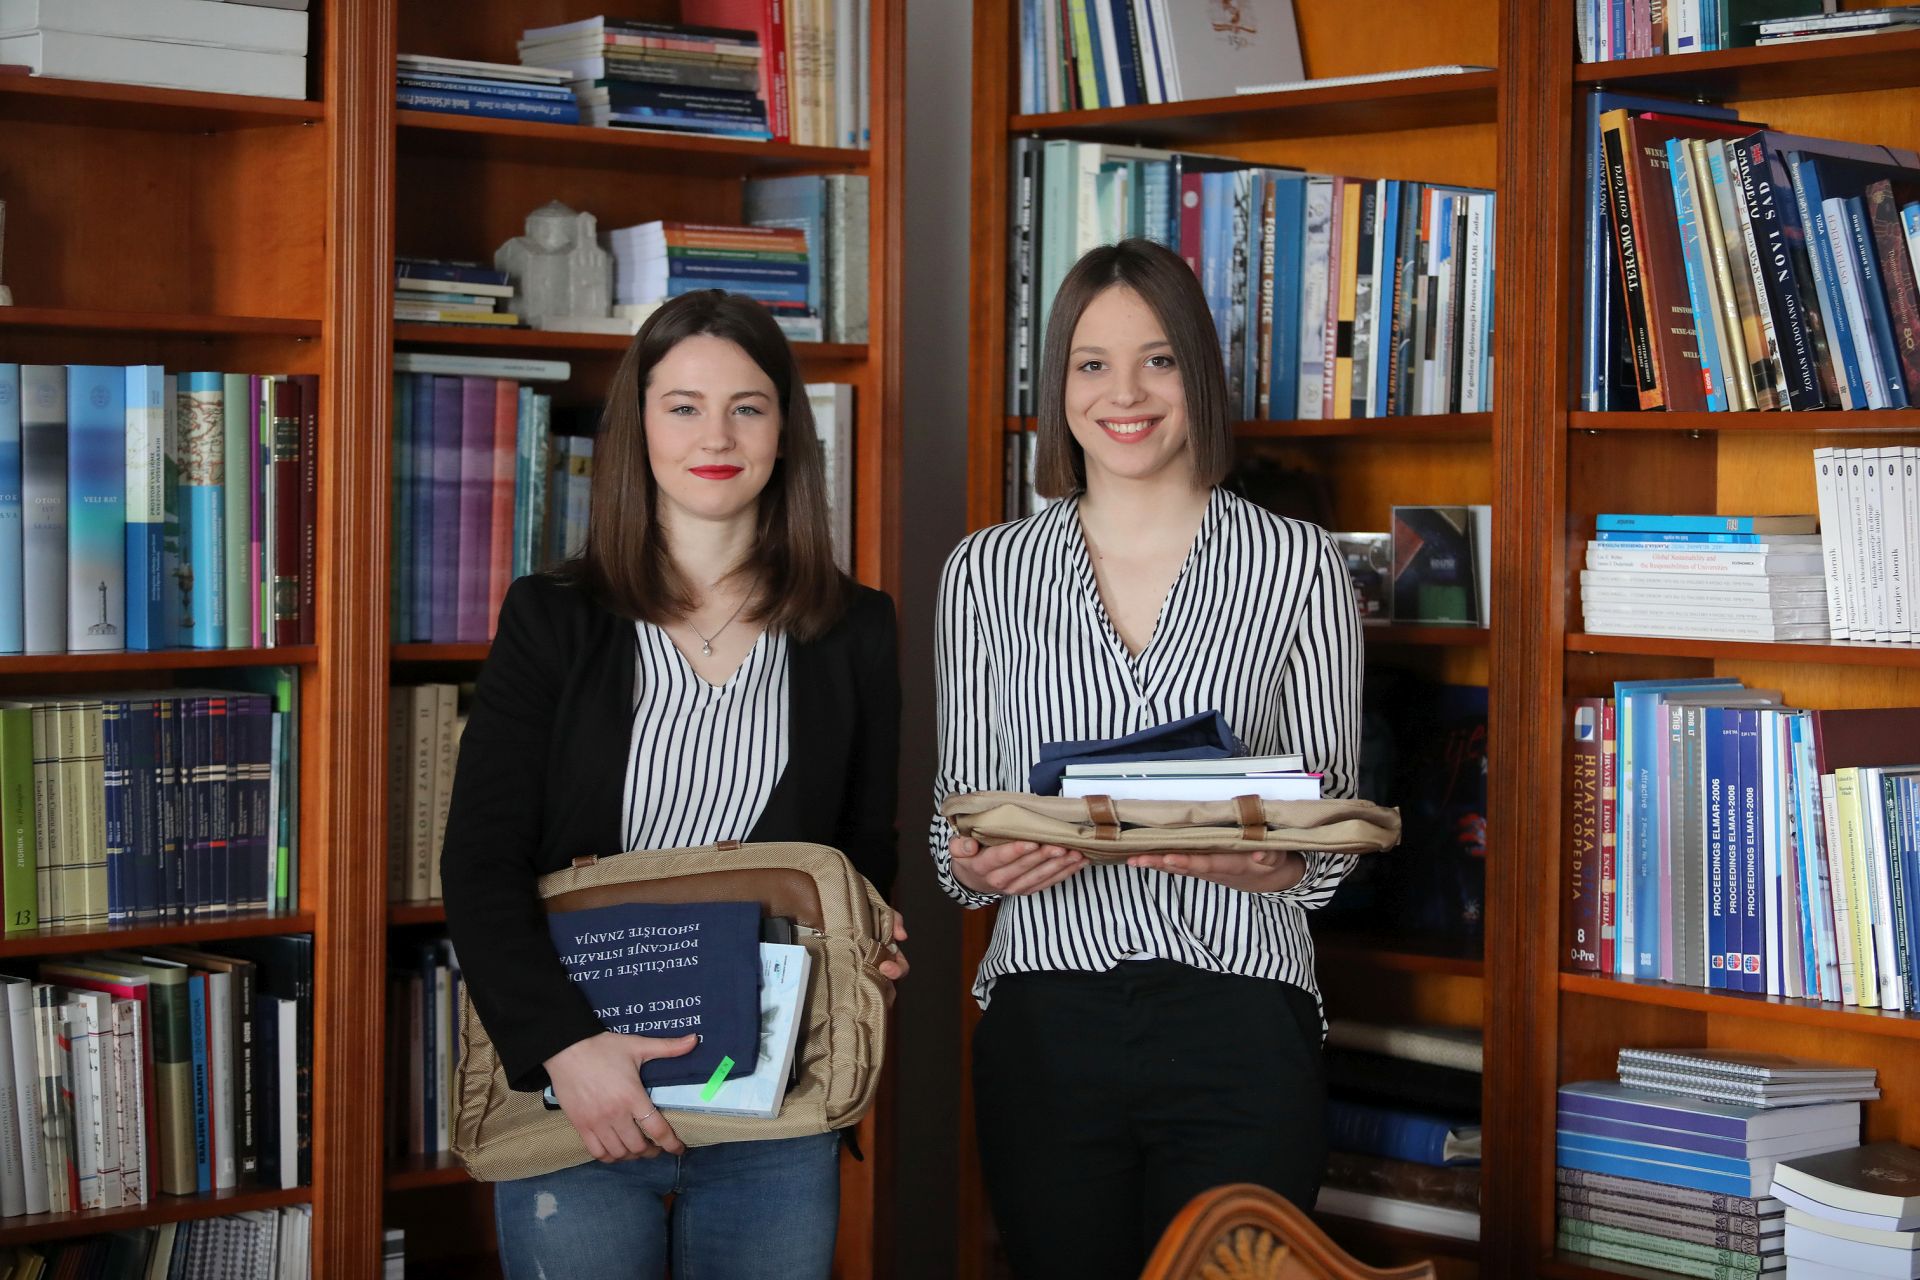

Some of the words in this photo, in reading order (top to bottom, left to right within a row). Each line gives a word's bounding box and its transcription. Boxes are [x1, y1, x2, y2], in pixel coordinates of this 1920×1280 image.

[1758, 181, 1778, 220] SAD
[1798, 198, 1808, 212] Light
[1472, 212, 1482, 236] Zadar
[1803, 220, 1814, 241] Change
[1815, 213, 1825, 235] TUZLA
[1852, 214, 1861, 231] BRNO
[1263, 218, 1275, 274] FOREIGN
[1471, 245, 1480, 277] ELMAR
[1620, 224, 1639, 292] TERAMO
[1768, 230, 1790, 283] NOVI
[1859, 244, 1868, 265] SPIRIT
[1807, 245, 1822, 282] Lichtwechsel
[1864, 266, 1872, 279] THE
[1262, 279, 1274, 324] OFFICE
[1393, 257, 1403, 315] INNSBRUCK
[1392, 320, 1399, 332] OF
[1468, 314, 1478, 358] djelovanja
[1785, 293, 1805, 355] RADOVANOV
[1389, 337, 1398, 393] UNIVERSITY
[1466, 359, 1476, 390] godina
[1798, 357, 1813, 391] ZORAN
[1387, 399, 1395, 415] THE
[1649, 562, 1690, 571] Responsibilities
[1697, 563, 1728, 571] Universities
[1652, 554, 1669, 562] Global
[1671, 554, 1706, 563] Sustainability
[1829, 548, 1840, 581] zbornik
[1891, 548, 1901, 582] zbornik
[1893, 585, 1903, 624] Logarjev
[421, 709, 429, 718] II
[419, 738, 429, 790] ZADRA
[441, 720, 452, 777] ZADRA
[1584, 756, 1596, 852] HRVATSKA
[1712, 779, 1721, 839] ELMAR-2006
[1728, 785, 1736, 841] ELMAR-2008
[1746, 787, 1755, 844] ELMAR-2008
[418, 802, 428, 879] PROŠLOST
[1571, 754, 1584, 901] ENCIKLOPEDIJA
[17, 838, 25, 867] ZBORNIK
[1849, 838, 1857, 872] Mediterranean
[1713, 843, 1721, 916] PROCEEDINGS
[1729, 845, 1737, 913] PROCEEDINGS
[1747, 847, 1755, 916] PROCEEDINGS
[15, 910, 31, 926] 13
[629, 923, 700, 939] ISHODIŠTE
[1854, 911, 1862, 936] Emergency
[1896, 907, 1904, 930] Management
[575, 930, 625, 945] ZNANJA
[627, 938, 698, 956] POTICANJE
[1577, 929, 1585, 943] 8
[617, 956, 698, 975] SVEUČILIŠTE
[1571, 951, 1595, 963] O-Pre
[1857, 948, 1865, 977] Management
[604, 968, 613, 978] U
[625, 1003, 643, 1014] OF
[649, 996, 701, 1012] SOURCE
[635, 1014, 701, 1032] RESEARCH
[196, 1064, 204, 1115] DALMATIN
